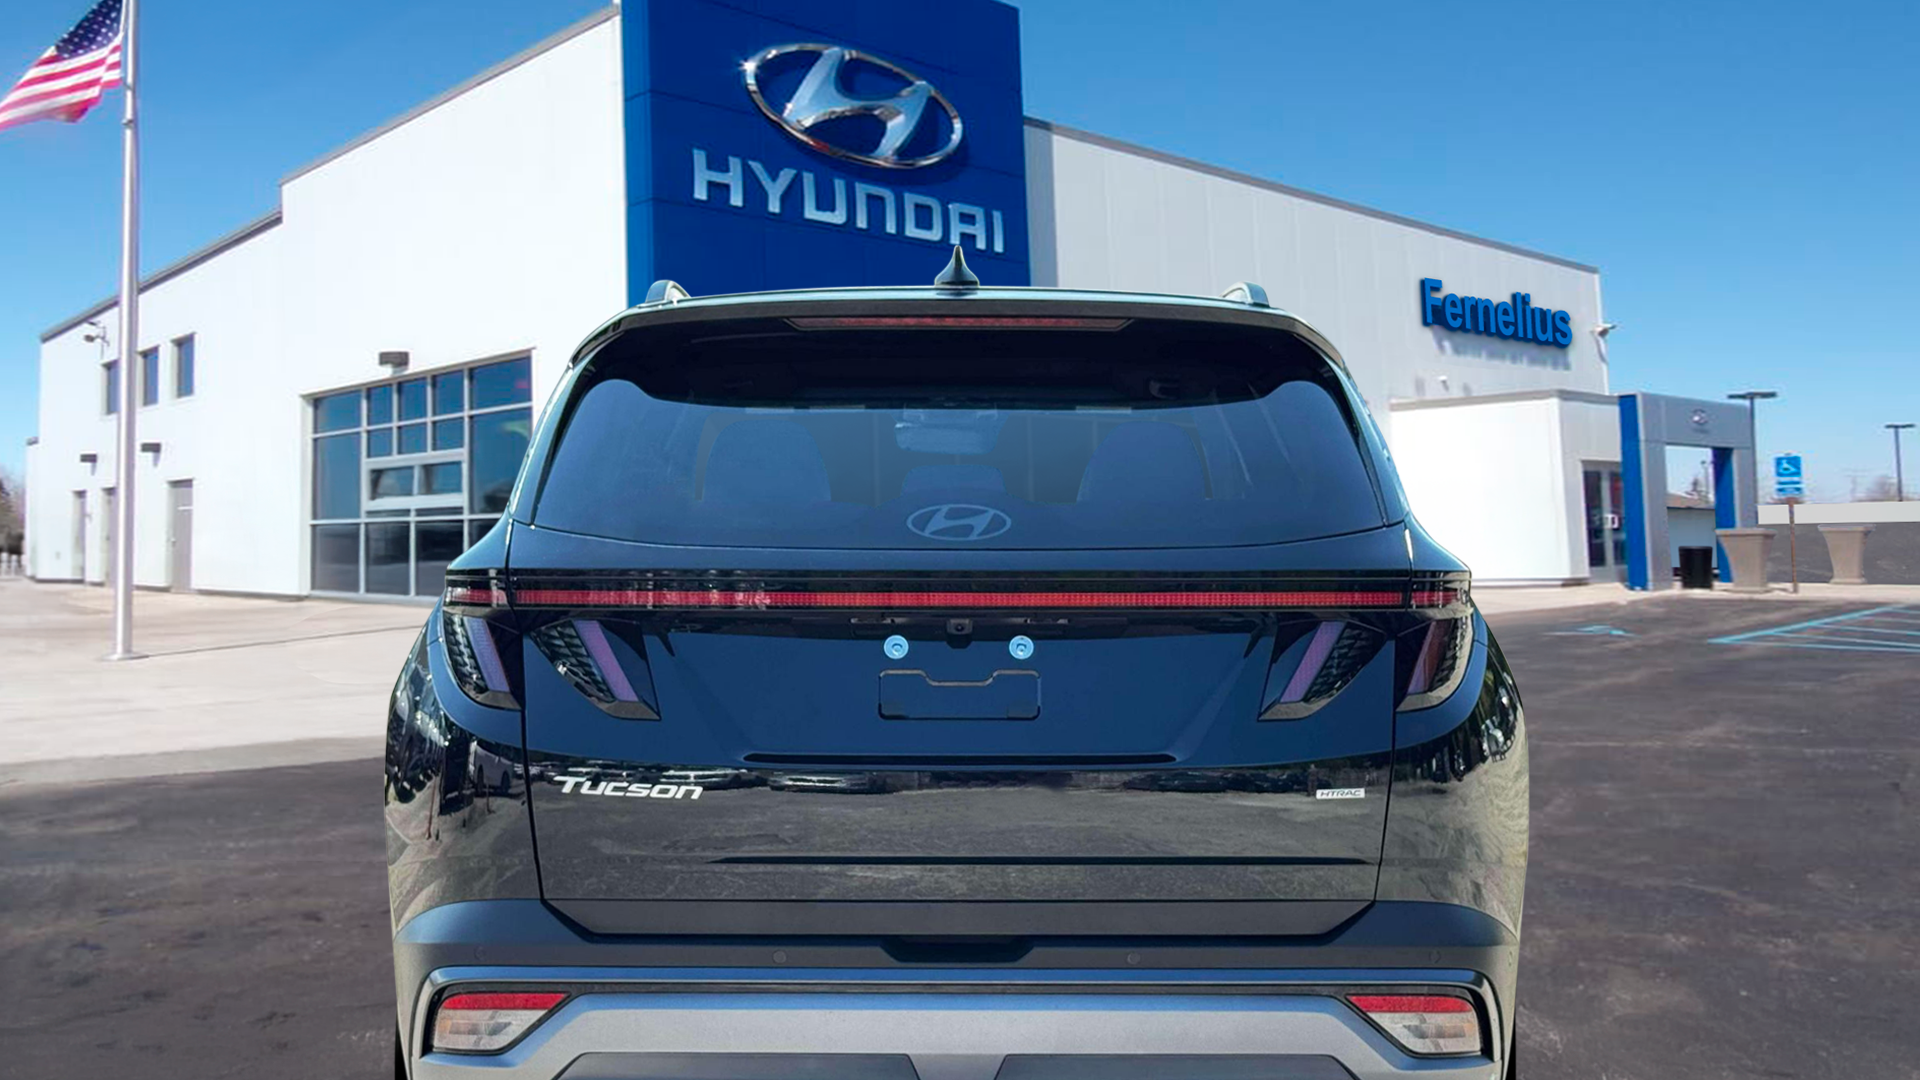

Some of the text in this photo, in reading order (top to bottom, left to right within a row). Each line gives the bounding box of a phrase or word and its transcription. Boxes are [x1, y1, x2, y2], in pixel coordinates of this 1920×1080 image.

[692, 148, 1004, 253] HYUNDAI
[1420, 277, 1573, 348] Fernelius
[1320, 789, 1362, 797] HTRAC
